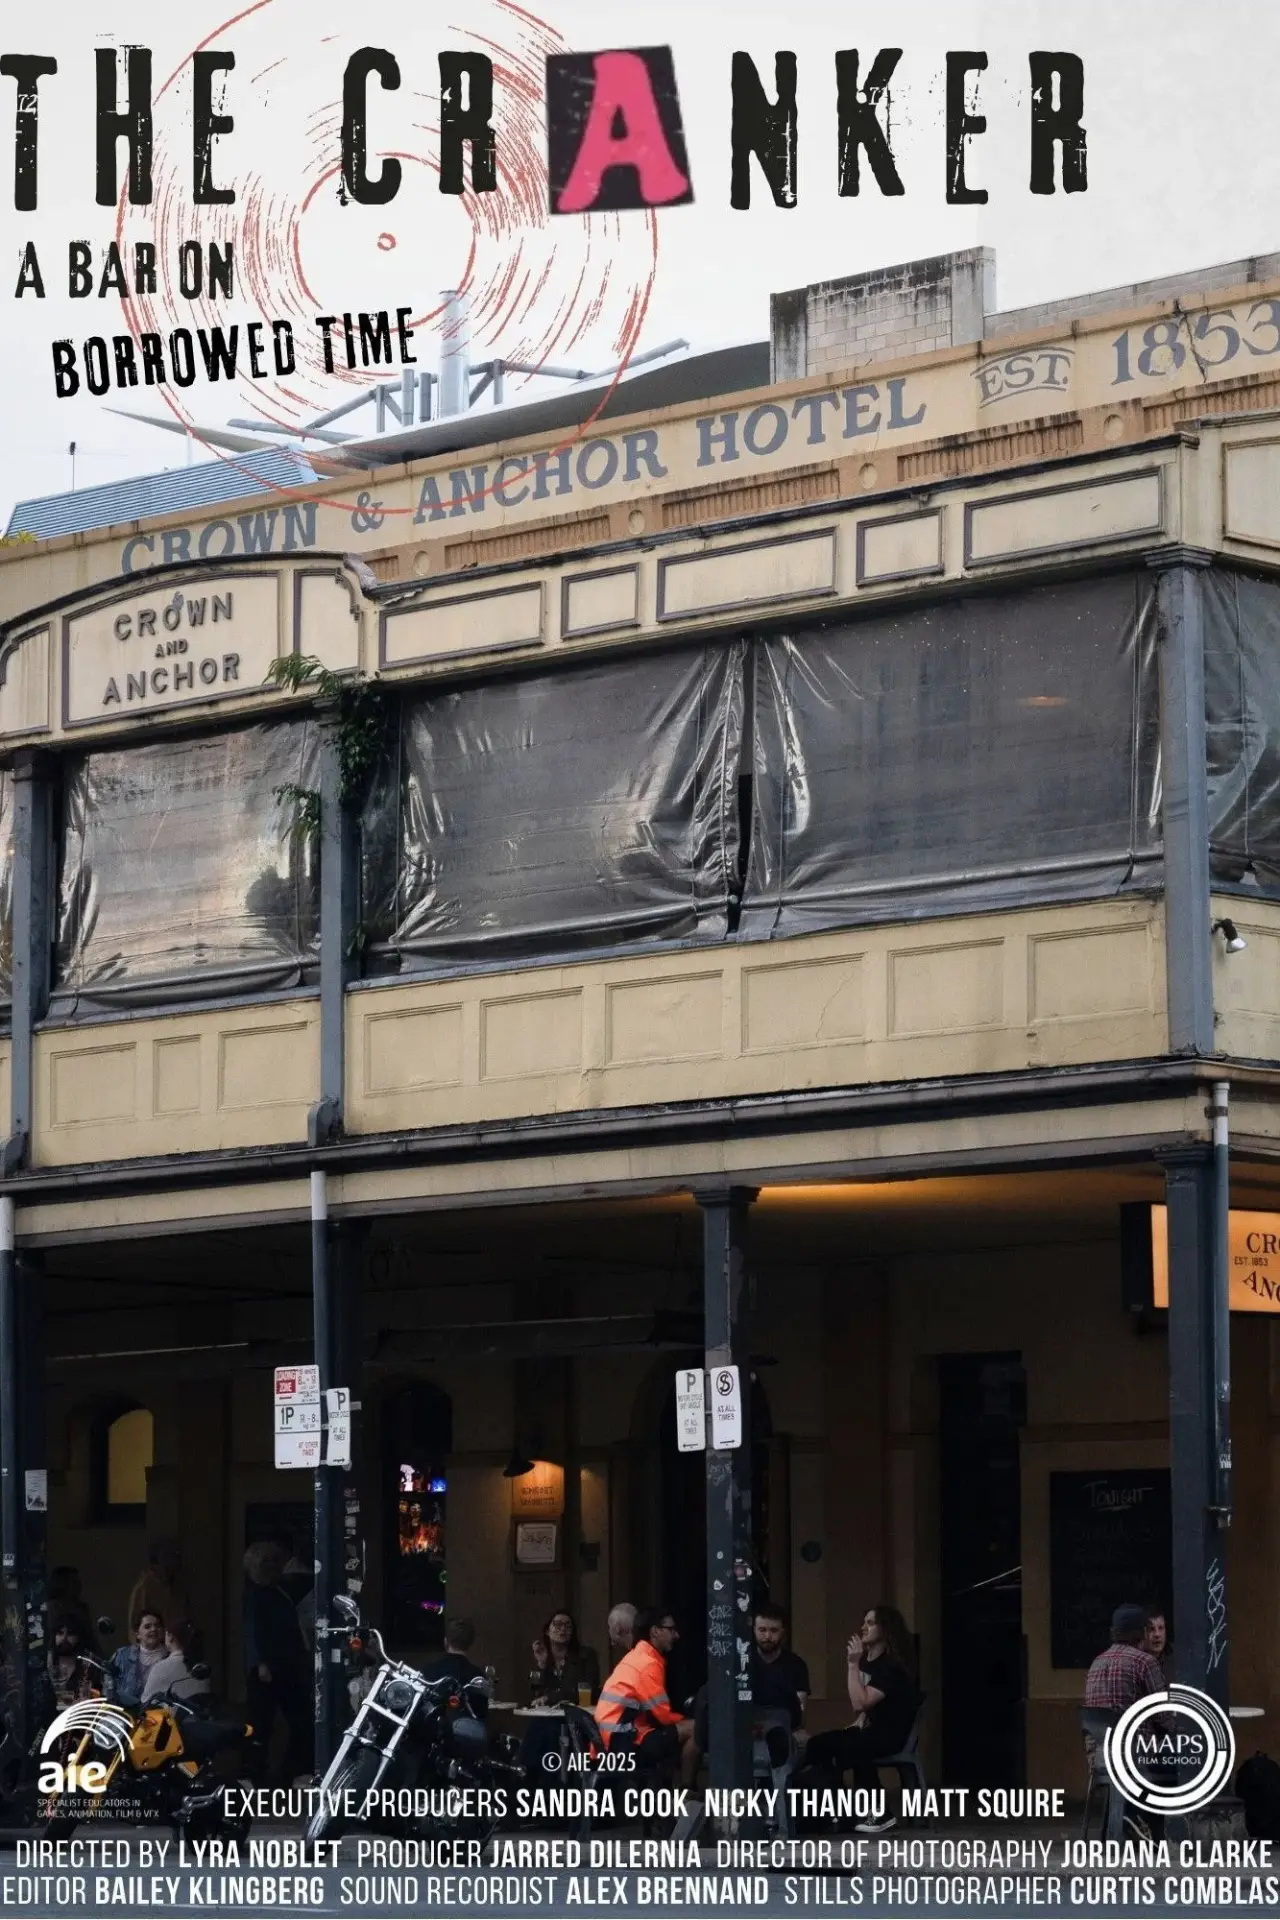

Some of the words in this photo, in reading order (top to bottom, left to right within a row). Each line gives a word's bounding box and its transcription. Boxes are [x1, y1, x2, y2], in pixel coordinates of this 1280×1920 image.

[121, 502, 318, 575] CROWN
[351, 491, 385, 533] &
[413, 429, 668, 525] ANCHOR
[696, 377, 927, 468] HOTEL
[974, 354, 1071, 401] EST.
[1110, 299, 1280, 386] 1853
[114, 592, 233, 641] CROWN
[155, 639, 188, 658] AND
[102, 653, 241, 706] ANCHOR
[1246, 1232, 1280, 1255] CR
[1242, 1270, 1280, 1304] AN
